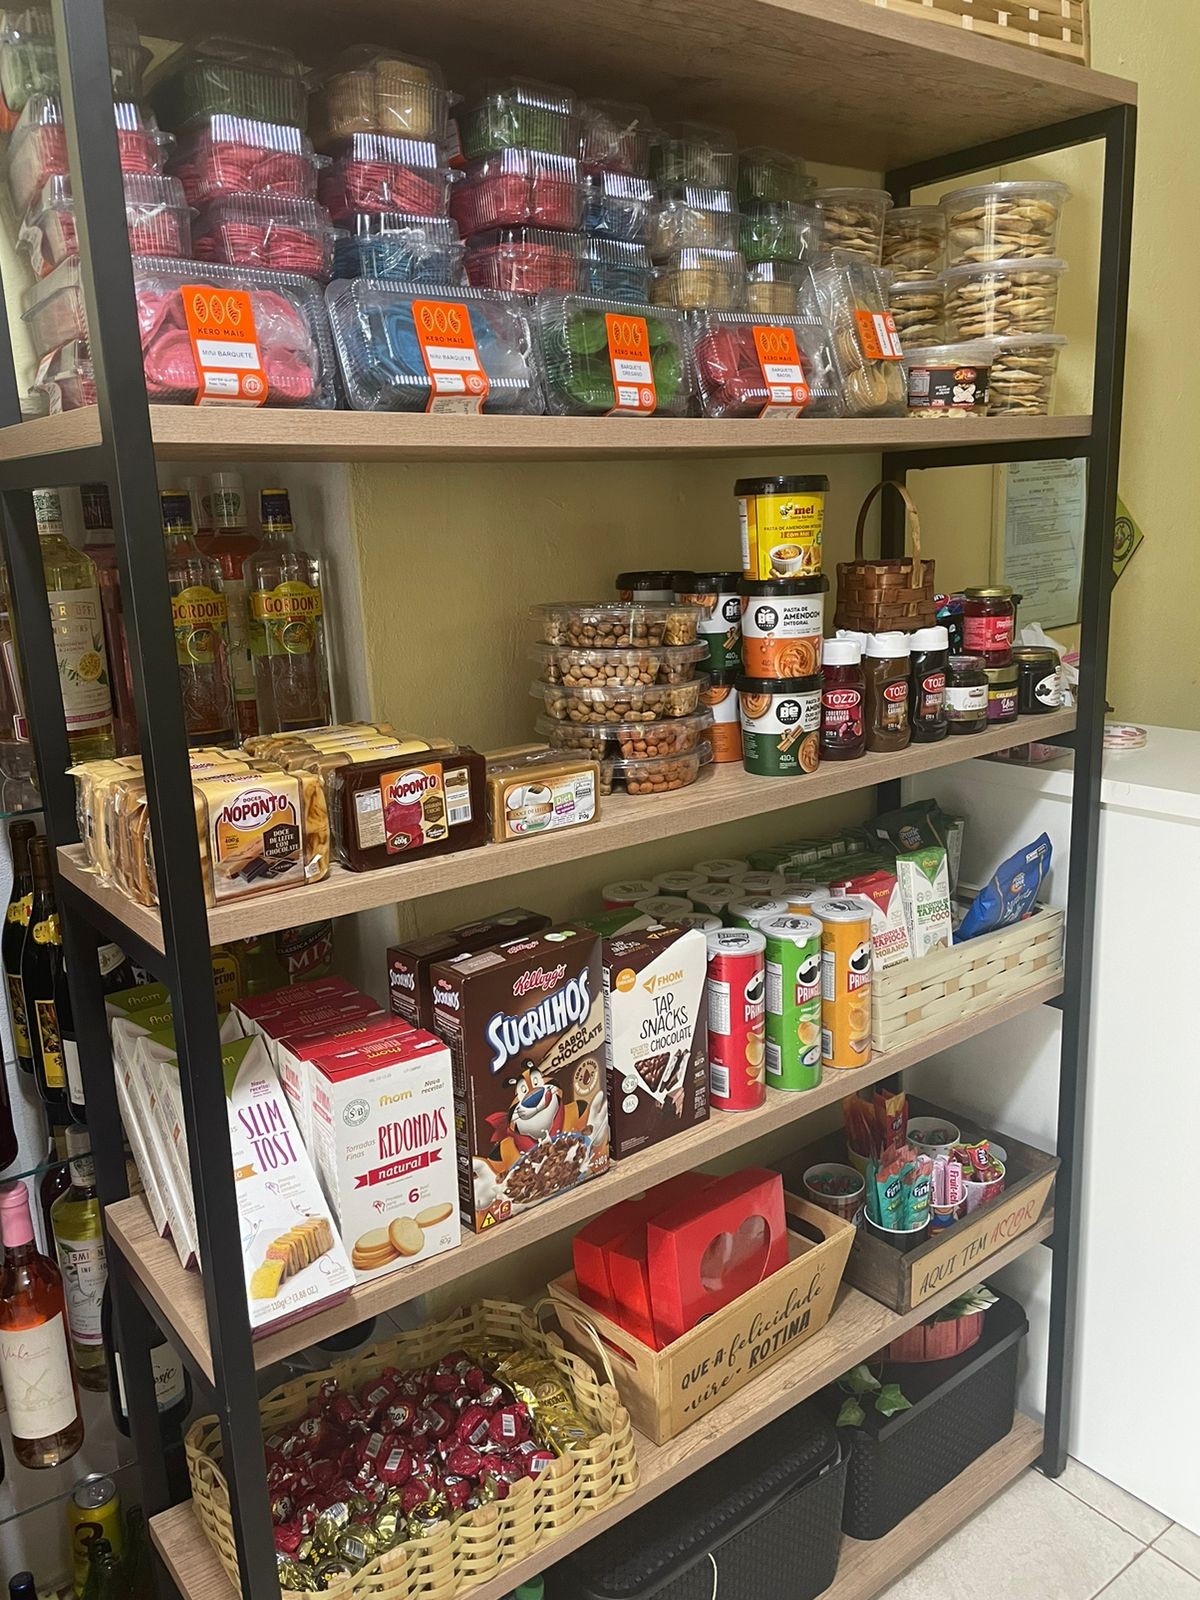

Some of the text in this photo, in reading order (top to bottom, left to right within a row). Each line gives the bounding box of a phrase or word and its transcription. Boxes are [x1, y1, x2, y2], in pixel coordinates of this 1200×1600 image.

[198, 328, 220, 336] KERO
[218, 351, 254, 359] BARQUETE
[794, 505, 814, 515] mel
[889, 685, 907, 697] TOZZ
[927, 677, 945, 689] TOZZ
[827, 693, 856, 704] TOZZI
[389, 775, 437, 799] NOPONTO
[222, 794, 287, 823] NOPONTO
[273, 828, 290, 836] DOCE
[265, 844, 299, 857] CHOCOLATE
[873, 888, 890, 899] fhom
[917, 902, 950, 917] TAPIOCA
[930, 910, 950, 922] COCO
[873, 931, 907, 948] TAPIOCA
[288, 932, 333, 973] MIX
[875, 941, 909, 958] MORANGO
[512, 963, 568, 996] Kellogg's
[657, 969, 685, 987] FHOM
[652, 992, 674, 1016] TAP
[149, 1013, 173, 1026] fho
[487, 968, 590, 1073] SUCRILHOS
[639, 1005, 689, 1040] SNACKS
[551, 1022, 604, 1068] CHOCOLATE
[558, 1026, 588, 1054] SABOR
[650, 1025, 692, 1052] CHOCOLATE
[424, 1078, 441, 1087] Nova
[378, 1089, 413, 1108] fhom
[237, 1098, 287, 1140] SLIM
[378, 1106, 448, 1160] REDONDAS
[250, 1130, 298, 1172] TOST
[345, 1139, 376, 1153] Torradas
[345, 1151, 365, 1161] Finas
[378, 1156, 422, 1180] natural
[408, 1188, 420, 1203] 6
[919, 1254, 957, 1296] AQUI
[961, 1232, 988, 1267] TEM
[681, 1272, 823, 1390] QUE A felicidade
[748, 1309, 811, 1370] ROTINA
